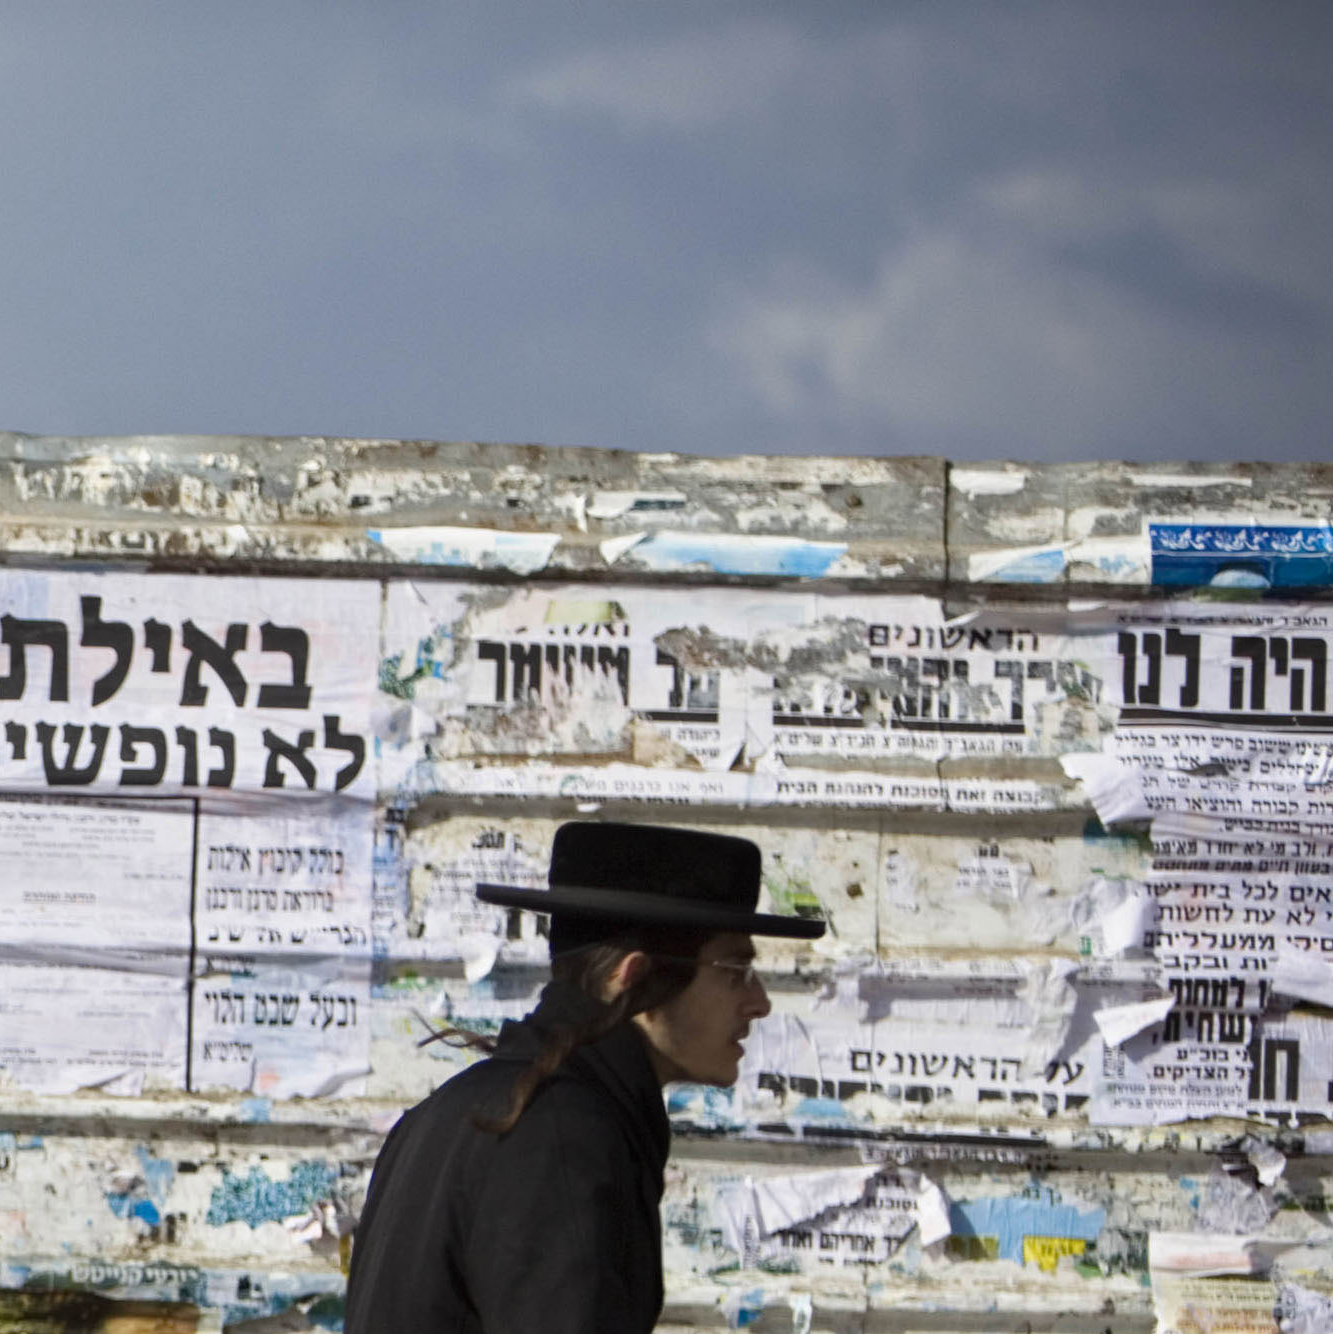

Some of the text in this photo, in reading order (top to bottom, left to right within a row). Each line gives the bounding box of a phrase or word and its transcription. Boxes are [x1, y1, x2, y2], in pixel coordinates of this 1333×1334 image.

[869, 624, 1039, 652] הראשונים
[1117, 628, 1201, 707] לנו
[1229, 636, 1328, 711] היה
[262, 715, 366, 792] לא
[1252, 800, 1299, 815] קבורה
[1191, 883, 1231, 899] בית
[1241, 881, 1279, 900] לכל
[1243, 907, 1276, 924] עת
[1286, 905, 1316, 926] לא
[851, 1049, 1022, 1082] הראשונים
